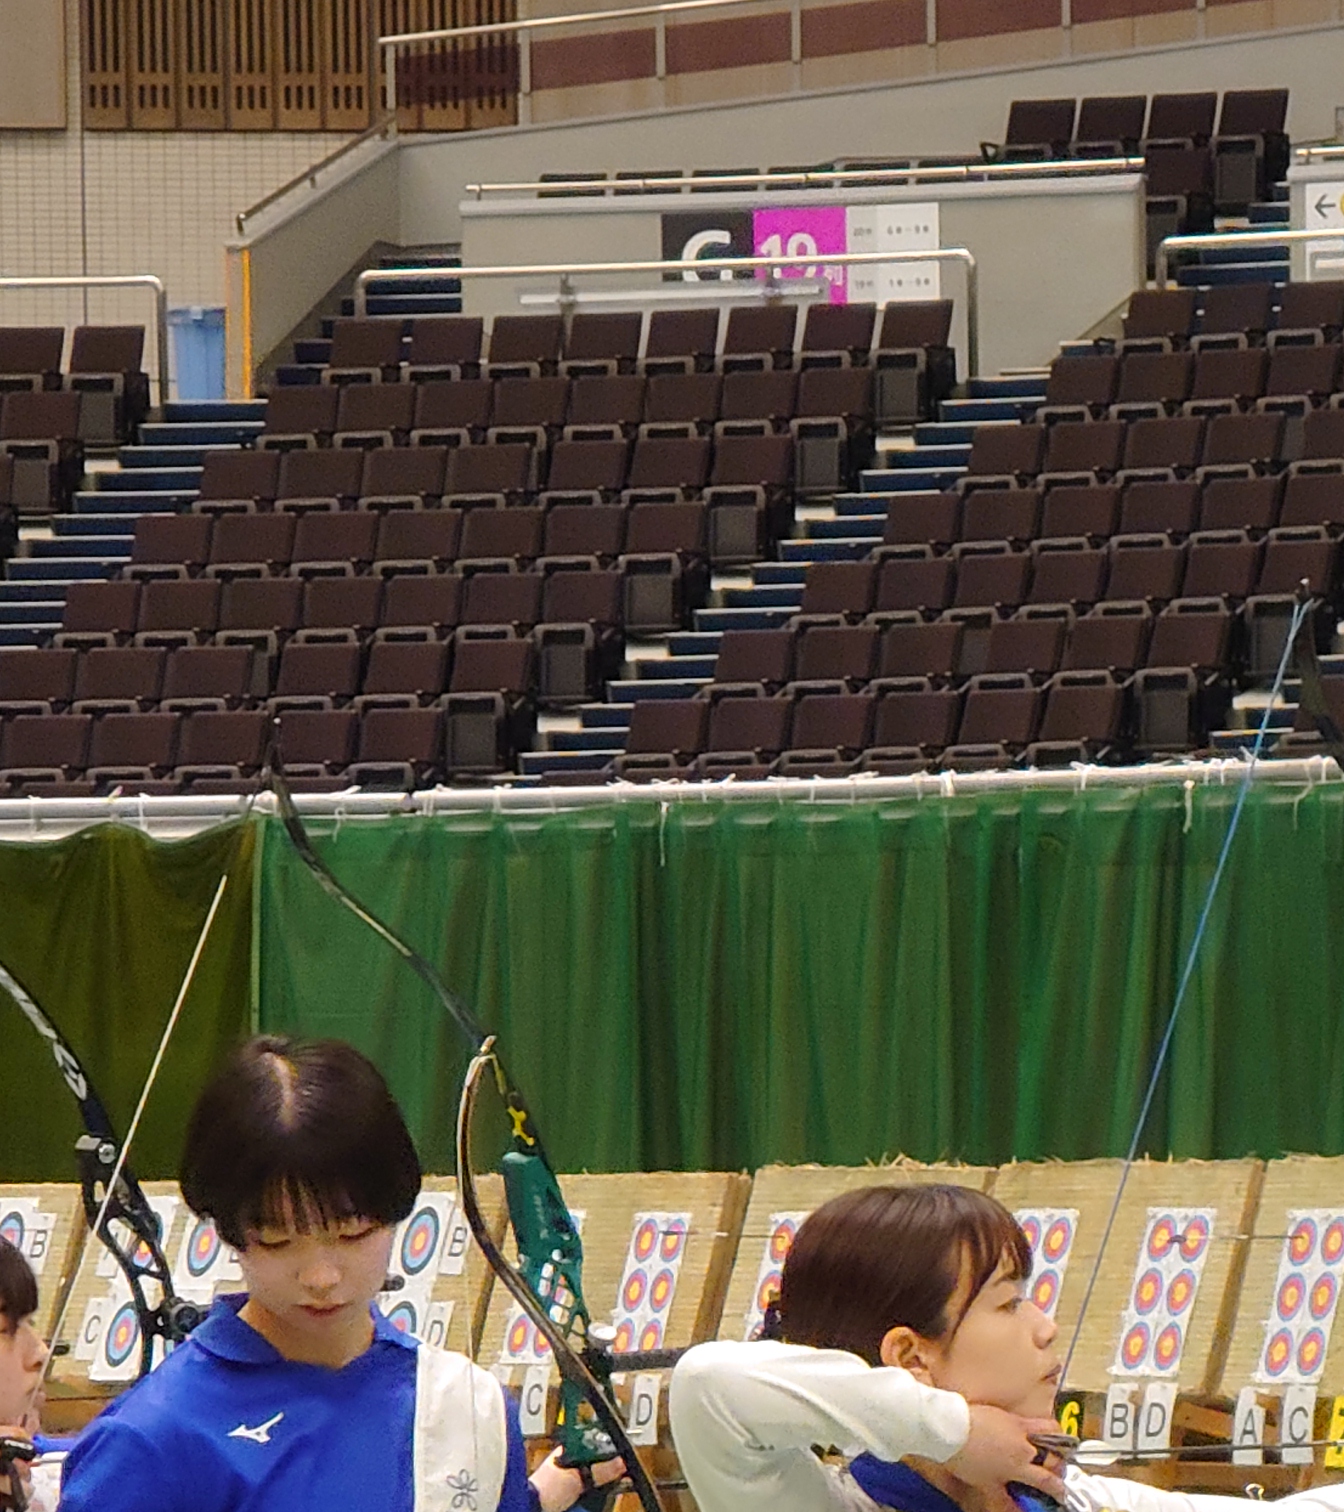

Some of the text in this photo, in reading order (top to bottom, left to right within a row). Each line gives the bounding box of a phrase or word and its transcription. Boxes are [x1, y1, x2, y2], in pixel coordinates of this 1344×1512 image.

[29, 1229, 48, 1259] B
[448, 1226, 467, 1258] B
[84, 1314, 101, 1344] C
[526, 1383, 543, 1416] C
[636, 1392, 653, 1426] D
[1060, 1400, 1081, 1437] 6
[1109, 1402, 1129, 1439] B
[1145, 1402, 1166, 1438] D
[1240, 1408, 1258, 1444] A
[1288, 1406, 1309, 1444] C
